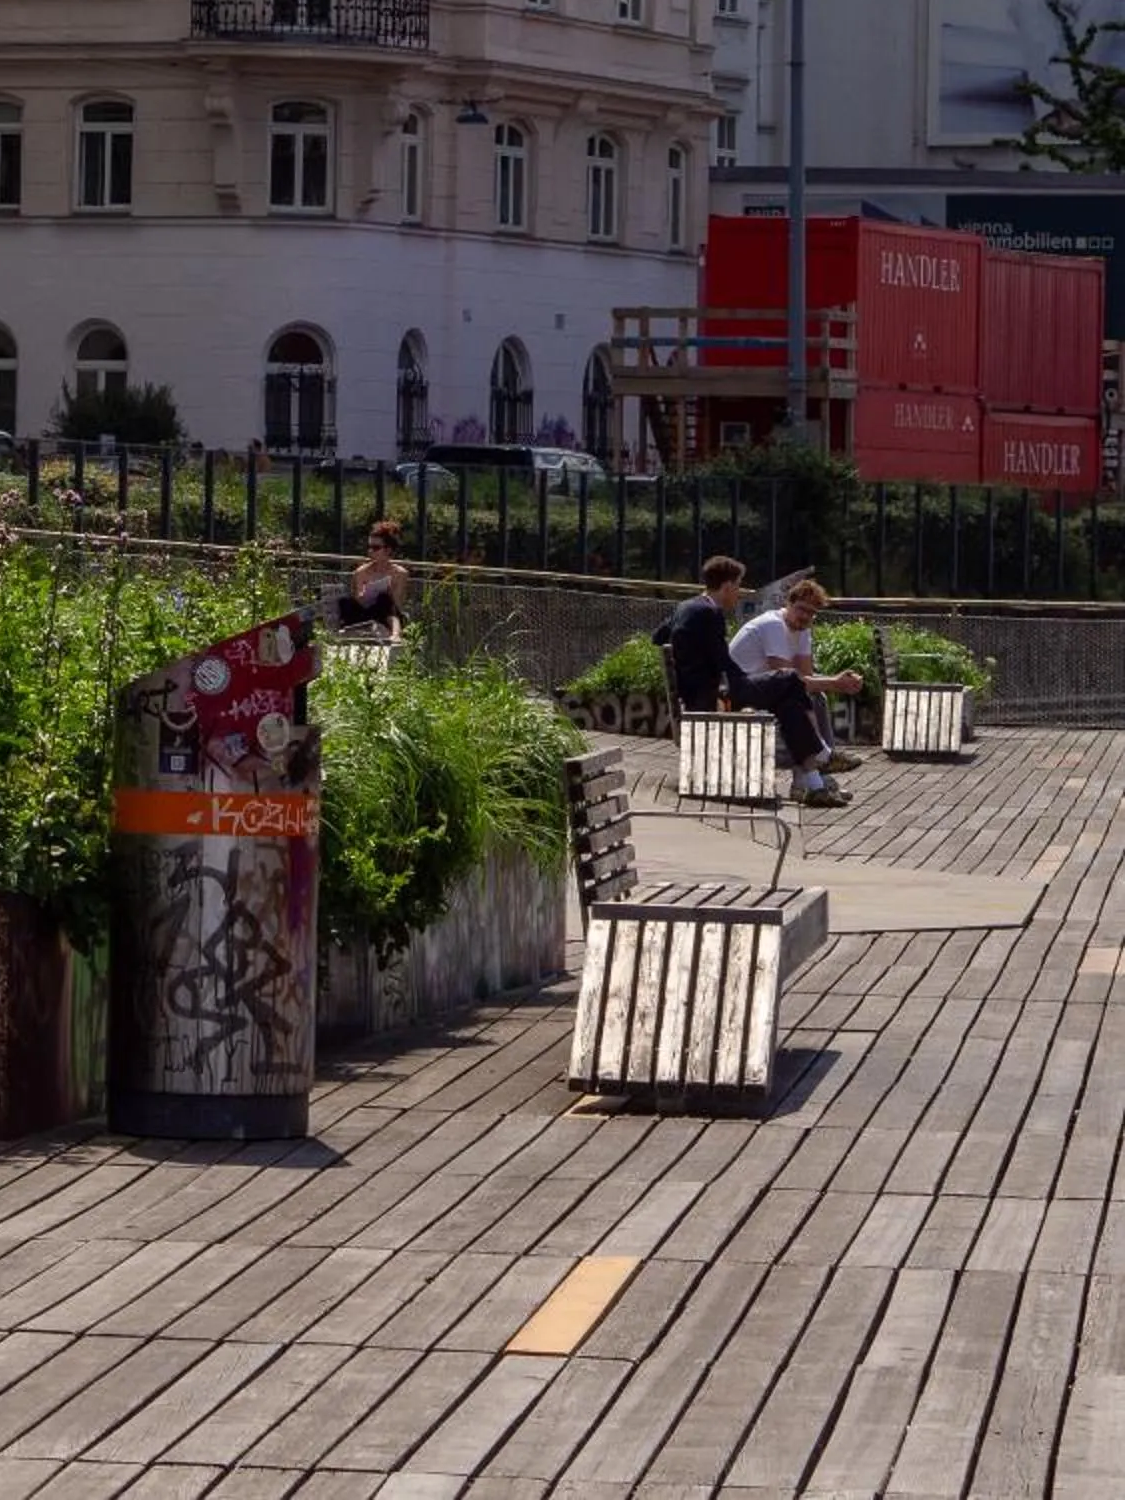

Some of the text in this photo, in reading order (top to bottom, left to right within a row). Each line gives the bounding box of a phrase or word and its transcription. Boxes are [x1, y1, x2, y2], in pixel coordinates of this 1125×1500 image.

[880, 251, 960, 292] HANDLER
[894, 403, 954, 431] HANDLER
[1003, 439, 1081, 476] HANDLER
